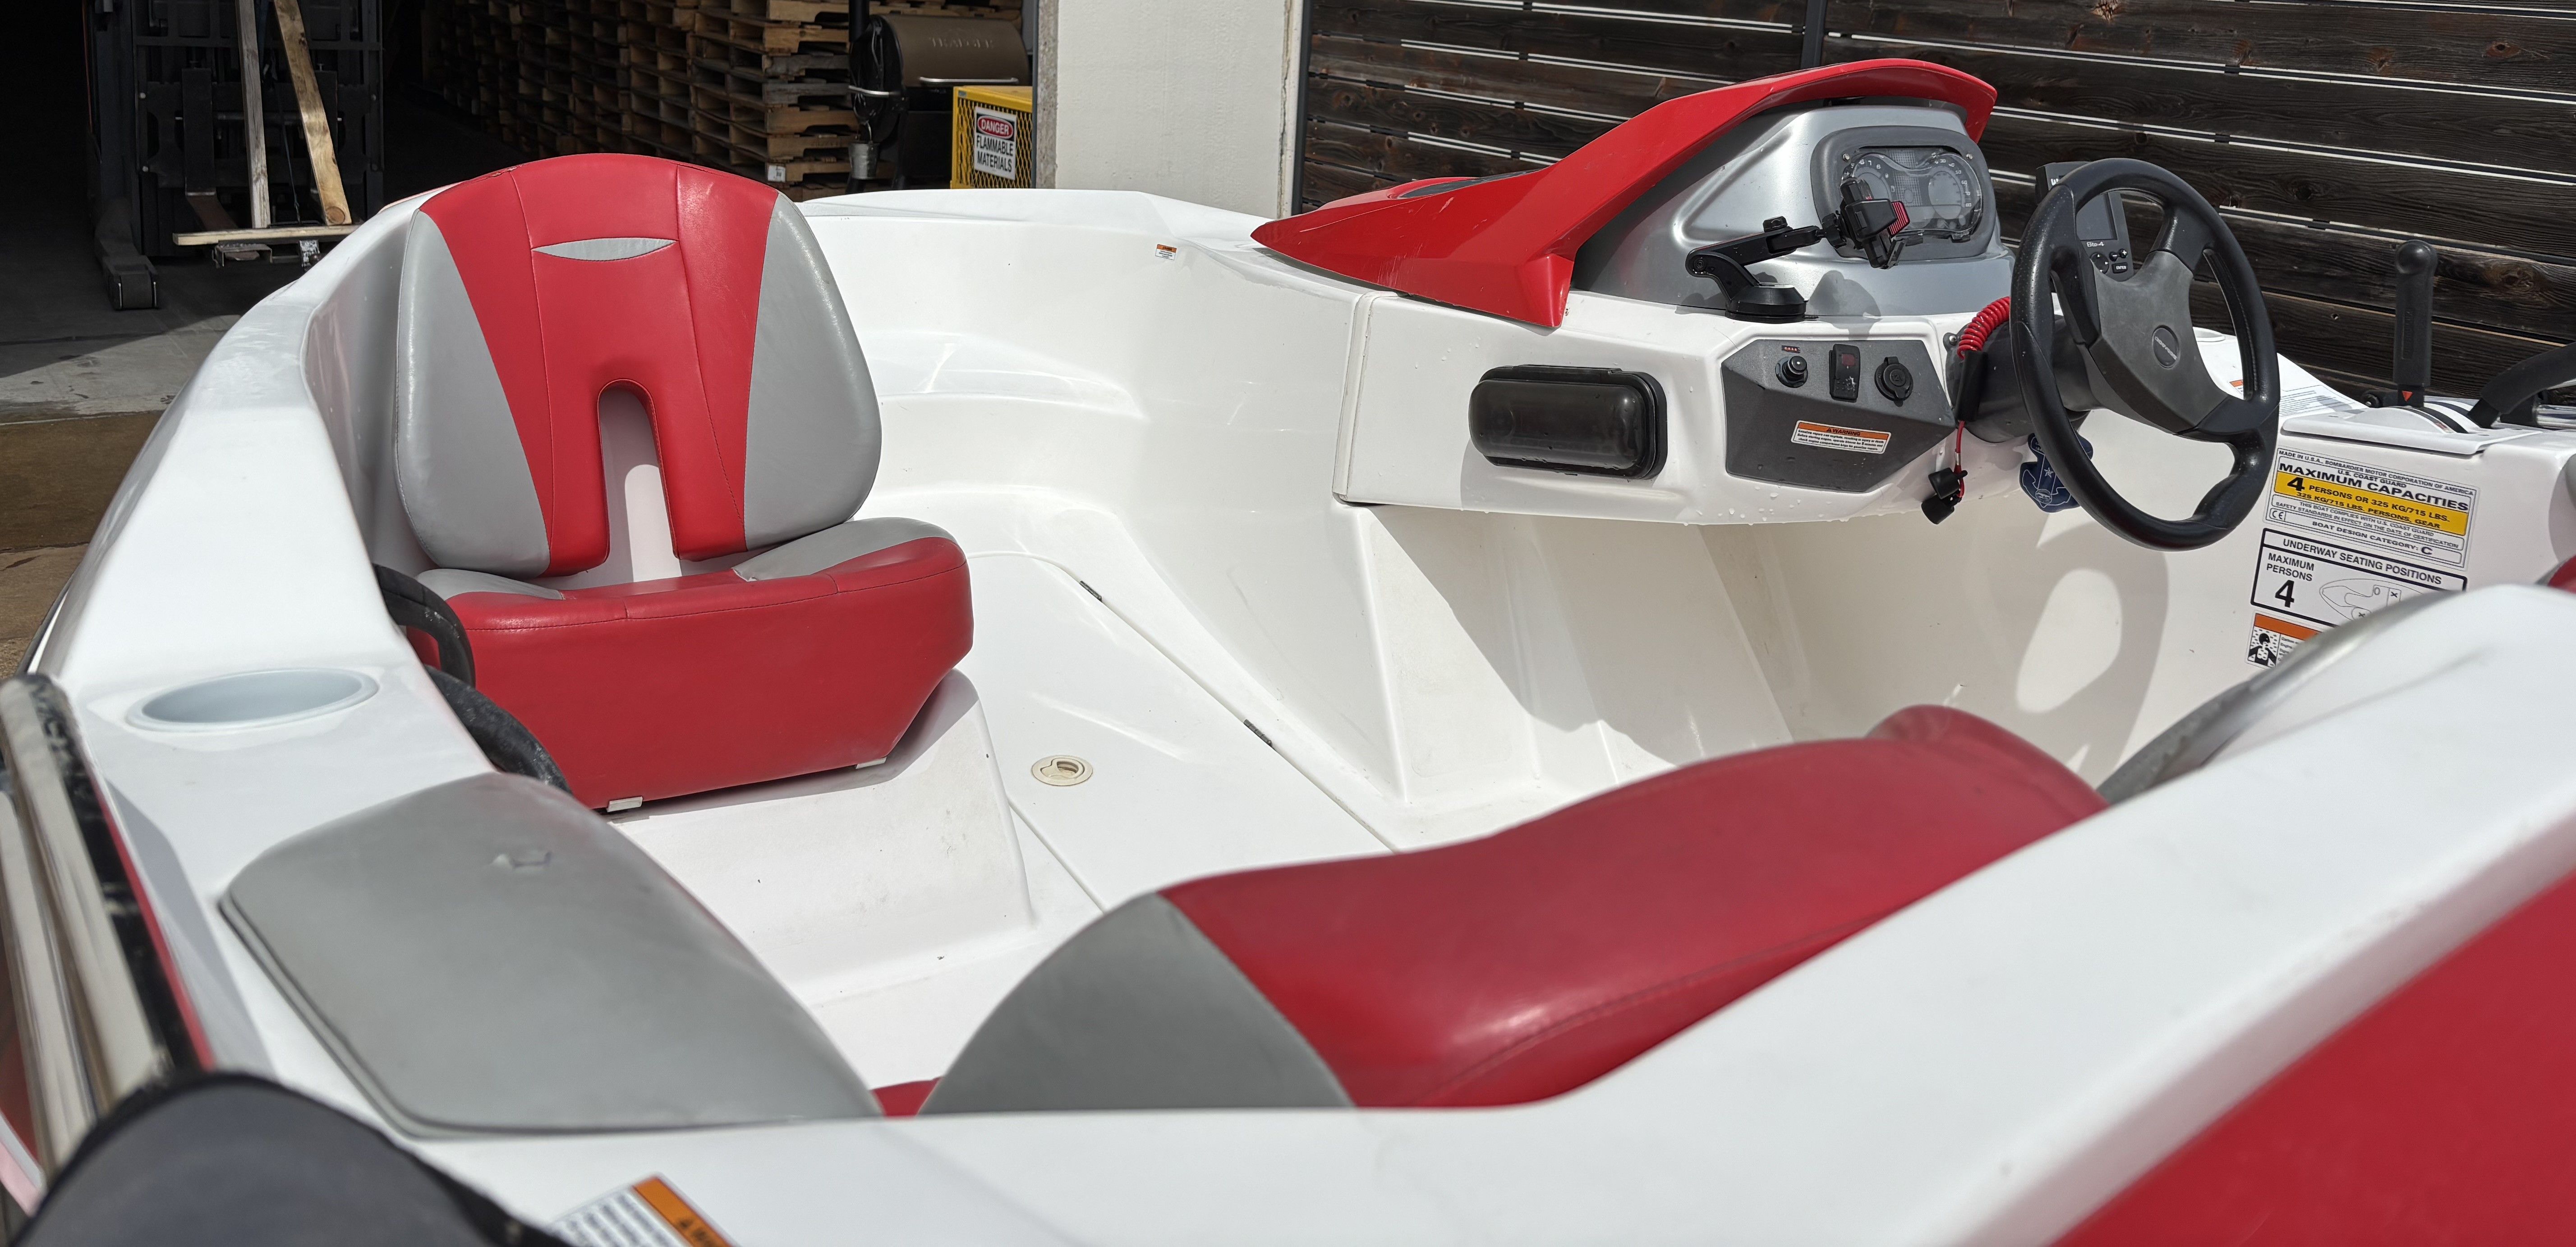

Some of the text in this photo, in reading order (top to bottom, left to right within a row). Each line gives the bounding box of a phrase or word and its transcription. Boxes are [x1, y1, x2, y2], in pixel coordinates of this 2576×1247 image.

[981, 119, 1010, 135] DANGER
[976, 135, 1013, 156] FLAMMABLE
[977, 151, 1012, 172] MATERIALS
[2279, 463, 2469, 511] MAXIMUM CAPACITIES
[2325, 460, 2364, 473] BOMBARDIER
[2365, 468, 2387, 477] MOTOR
[2388, 474, 2433, 487] CORPORATION
[2445, 486, 2474, 495] AMERICA
[2354, 473, 2378, 481] COAST
[2380, 479, 2407, 488] GUARD
[2287, 477, 2305, 492] 4
[2309, 485, 2352, 499] PERSONS
[2370, 499, 2389, 508] 325
[2392, 503, 2426, 517] KG/715
[2429, 512, 2450, 522] LBS.
[2314, 496, 2344, 506] KG/715
[2415, 519, 2440, 529] GEAR
[2276, 502, 2296, 510] SAFETY
[2298, 507, 2332, 518] STANDARDS
[2341, 517, 2361, 525] EFFECT
[2413, 534, 2459, 549] CERTIFICATION
[2330, 508, 2359, 519] COMPLIES
[2390, 523, 2410, 531] COAST
[2412, 528, 2434, 536] GUARD
[2313, 521, 2433, 555] BOAT DESIGN CATEGORY: C
[2267, 563, 2313, 582] PERSONS
[2268, 553, 2314, 571] MAXIMUM
[2283, 538, 2442, 585] UNDERWAY SEATING POSITIONS
[2275, 579, 2295, 608] 4
